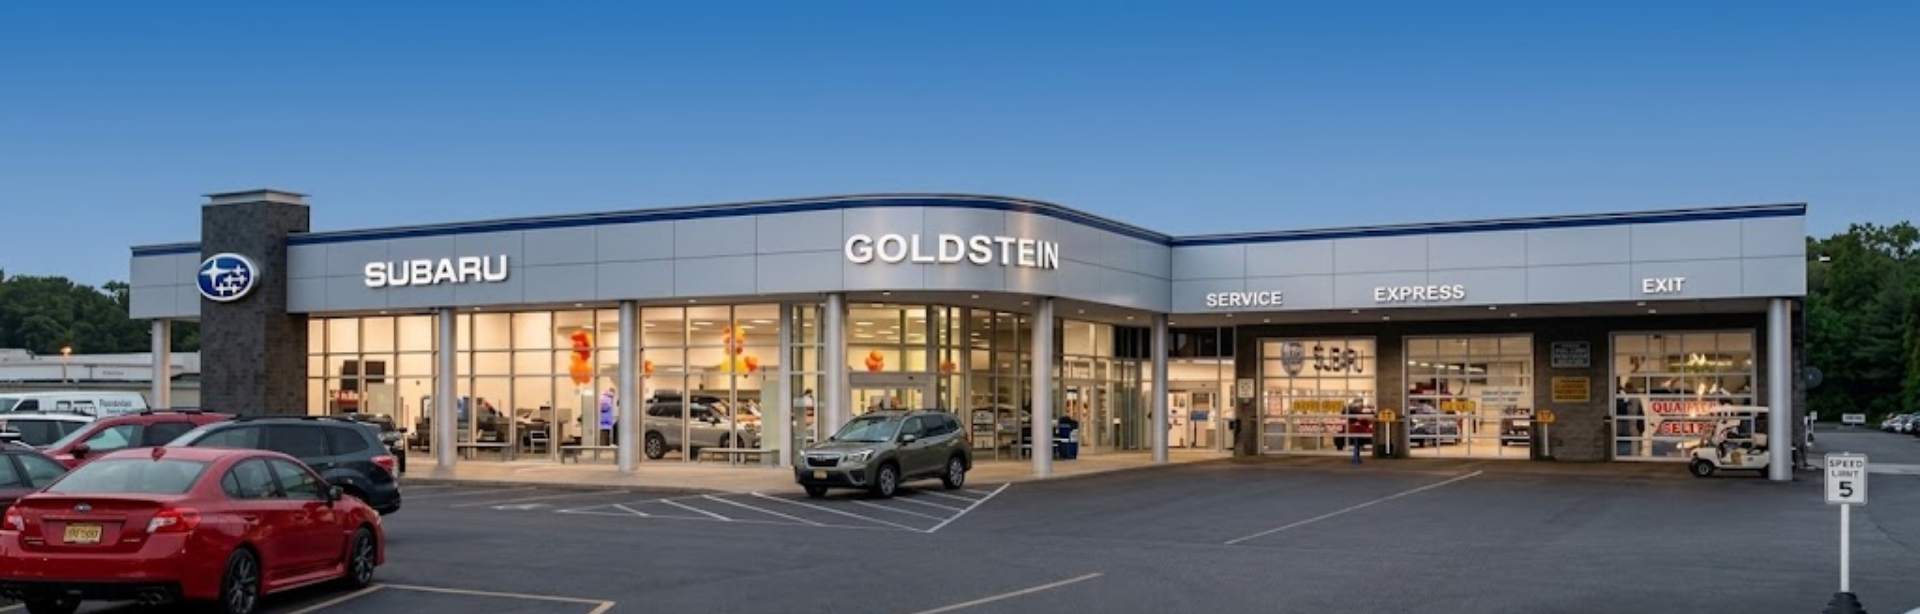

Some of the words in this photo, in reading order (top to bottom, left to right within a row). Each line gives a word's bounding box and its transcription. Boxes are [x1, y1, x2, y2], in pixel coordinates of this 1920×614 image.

[845, 233, 1059, 270] GOLDSTEIN
[364, 254, 508, 288] SUBARU
[1374, 284, 1466, 302] EXPRESS
[1642, 276, 1687, 294] EXIT
[1206, 291, 1283, 308] SERVICE
[1829, 459, 1863, 469] SPEED
[1839, 481, 1854, 498] 5
